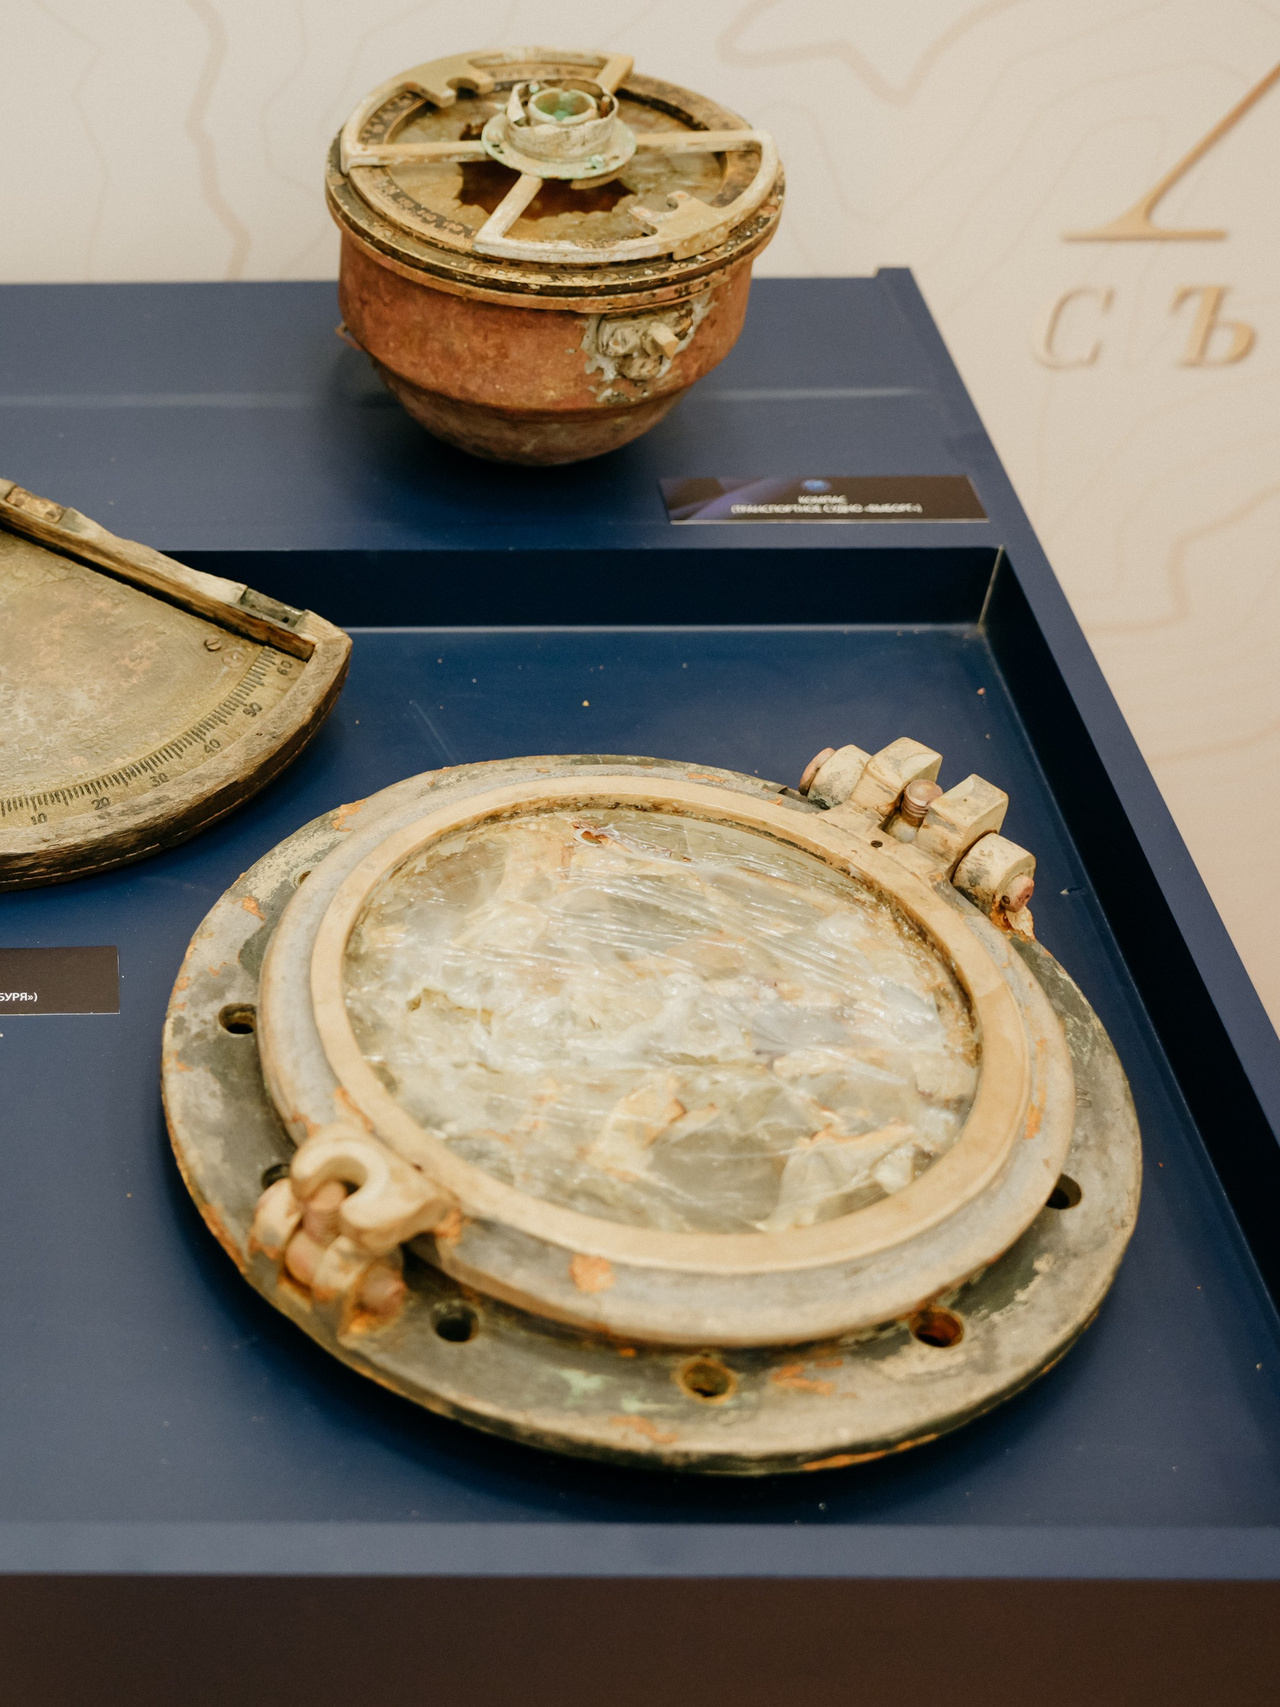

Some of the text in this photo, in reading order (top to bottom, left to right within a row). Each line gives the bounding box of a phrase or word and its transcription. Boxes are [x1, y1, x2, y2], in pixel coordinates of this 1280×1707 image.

[30, 812, 48, 826] 10
[91, 796, 111, 811] 20
[149, 772, 169, 788] 30
[203, 738, 222, 754] 40
